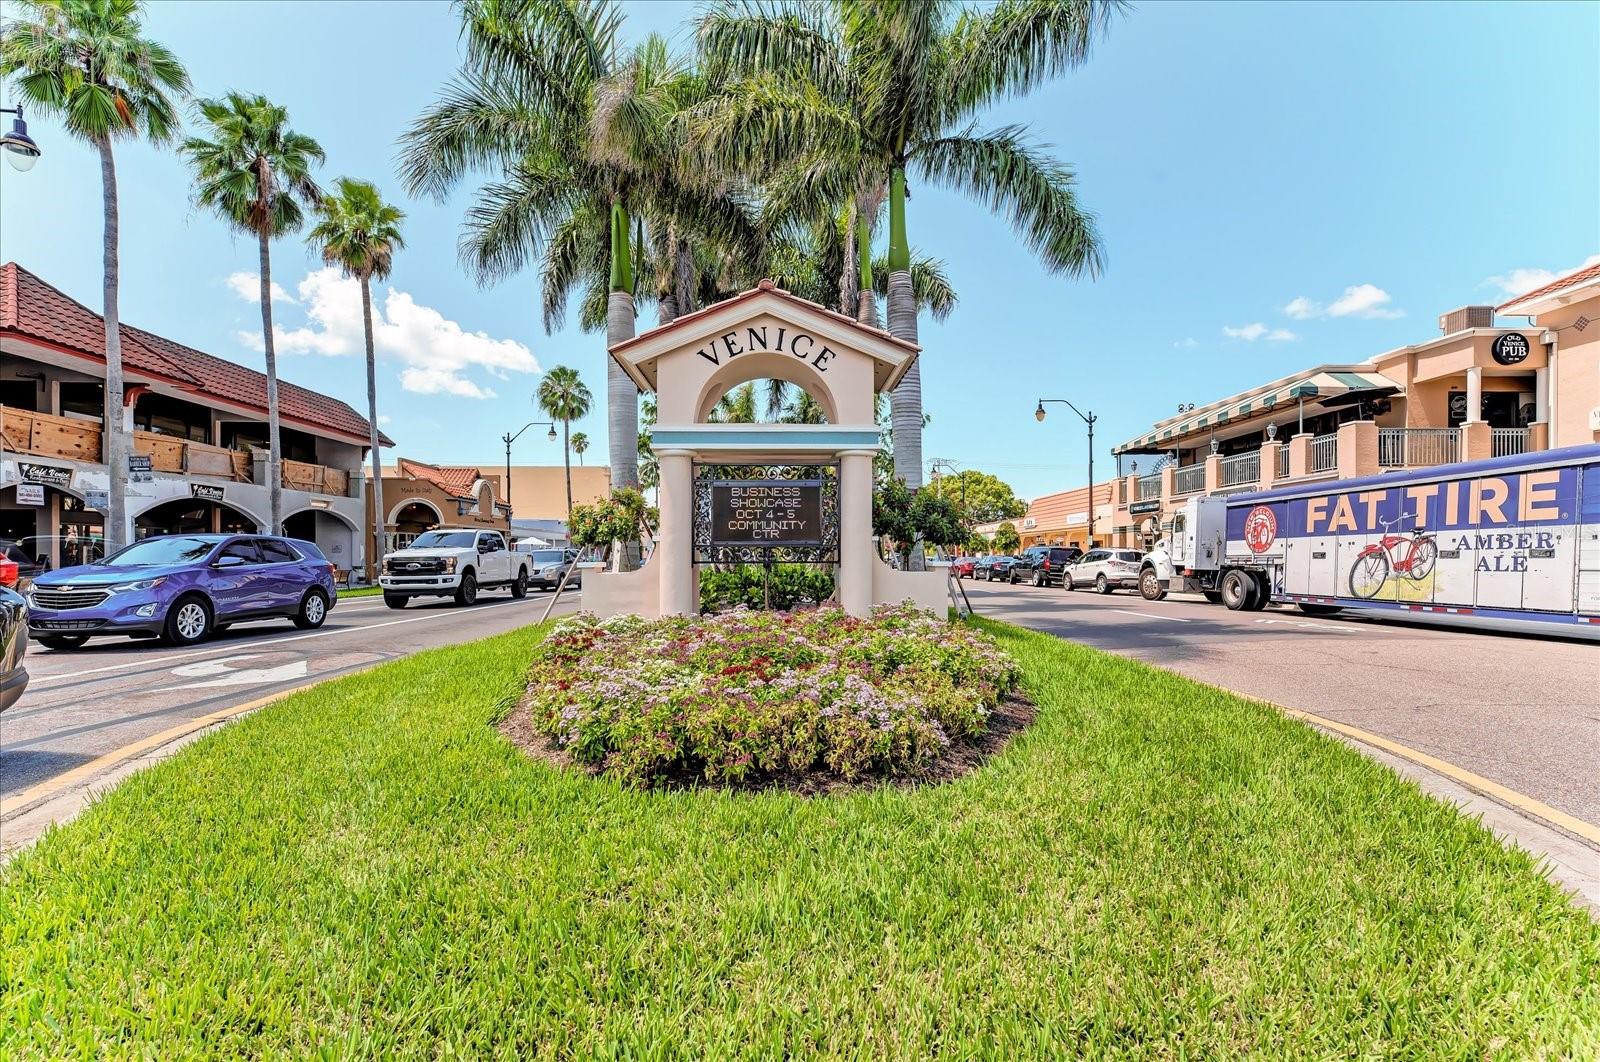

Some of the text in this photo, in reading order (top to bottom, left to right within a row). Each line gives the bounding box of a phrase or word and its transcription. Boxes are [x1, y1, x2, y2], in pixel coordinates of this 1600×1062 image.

[697, 326, 836, 372] VENICE
[1502, 346, 1527, 356] PUB
[731, 487, 801, 497] BUSINESS
[730, 498, 802, 508] SHOWCASE
[1306, 470, 1561, 533] FAT TIRE
[735, 509, 763, 519] OCT
[765, 509, 774, 519] 4
[786, 509, 796, 519] 5
[728, 520, 807, 530] COMMUNITY
[752, 529, 780, 539] CTR
[1456, 532, 1555, 551] AMBER
[1475, 555, 1528, 572] ALE
